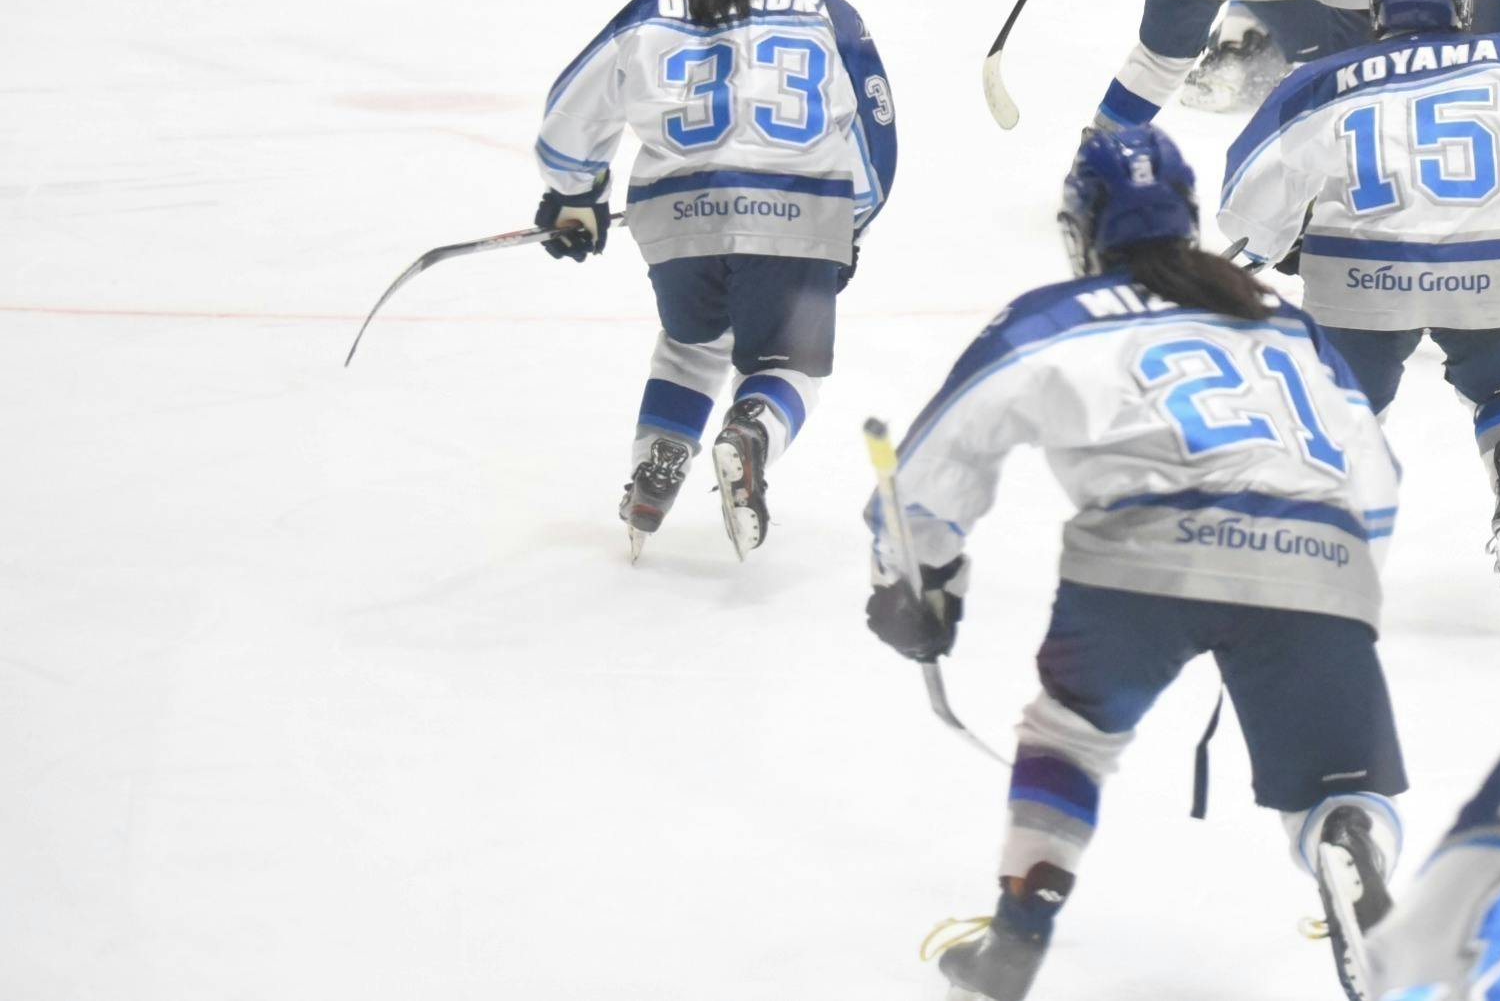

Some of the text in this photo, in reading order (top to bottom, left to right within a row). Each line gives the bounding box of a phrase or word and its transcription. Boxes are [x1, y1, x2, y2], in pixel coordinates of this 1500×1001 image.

[657, 29, 834, 153] 33
[1335, 39, 1499, 94] KOYAMA
[673, 193, 801, 221] Seibu Group
[1346, 265, 1491, 293] Seibu Group
[1131, 335, 1351, 479] 21
[1175, 516, 1351, 568] Seibu Group
